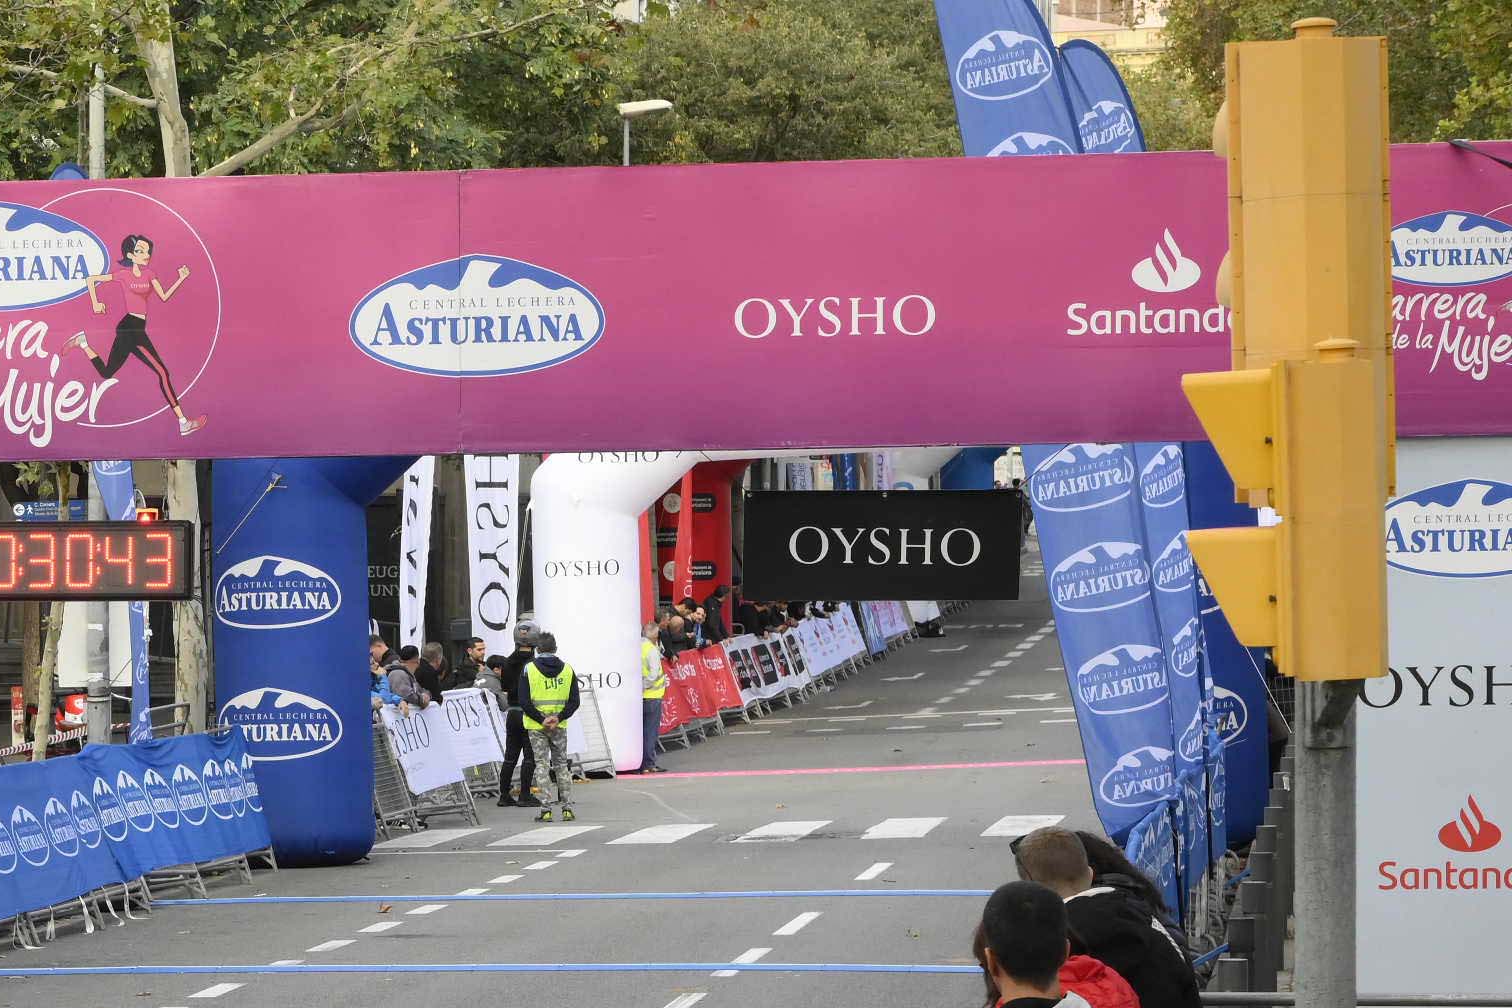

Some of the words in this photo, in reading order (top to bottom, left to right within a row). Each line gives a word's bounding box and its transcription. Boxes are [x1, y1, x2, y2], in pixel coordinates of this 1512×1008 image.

[13, 238, 85, 250] LECHERA
[1407, 236, 1457, 245] CENTRAL
[409, 297, 488, 310] CENTRAL
[495, 295, 577, 308] LECHERA
[734, 294, 936, 339] OYSHO
[1392, 292, 1487, 321] arrera
[369, 301, 585, 346] ASTURIANA
[1067, 302, 1232, 336] Santand
[1415, 322, 1433, 349] la
[1428, 315, 1512, 381] Muje
[1413, 513, 1480, 524] CENTRAL
[474, 455, 511, 631] OYSH
[789, 526, 981, 567] OYSHO
[1385, 517, 1512, 554] ASTURIA
[544, 558, 620, 578] OYSHO
[219, 585, 332, 613] ASTURIANA
[231, 580, 274, 590] CENTRAL
[278, 580, 327, 589] LECHERA
[577, 672, 622, 688] SHO
[1358, 664, 1512, 709] OYSH
[233, 712, 275, 721] CENTRAL
[279, 712, 328, 720] LECHERA
[445, 695, 481, 732] OYS
[223, 717, 333, 741] TURIANA
[1378, 861, 1512, 892] Santan
